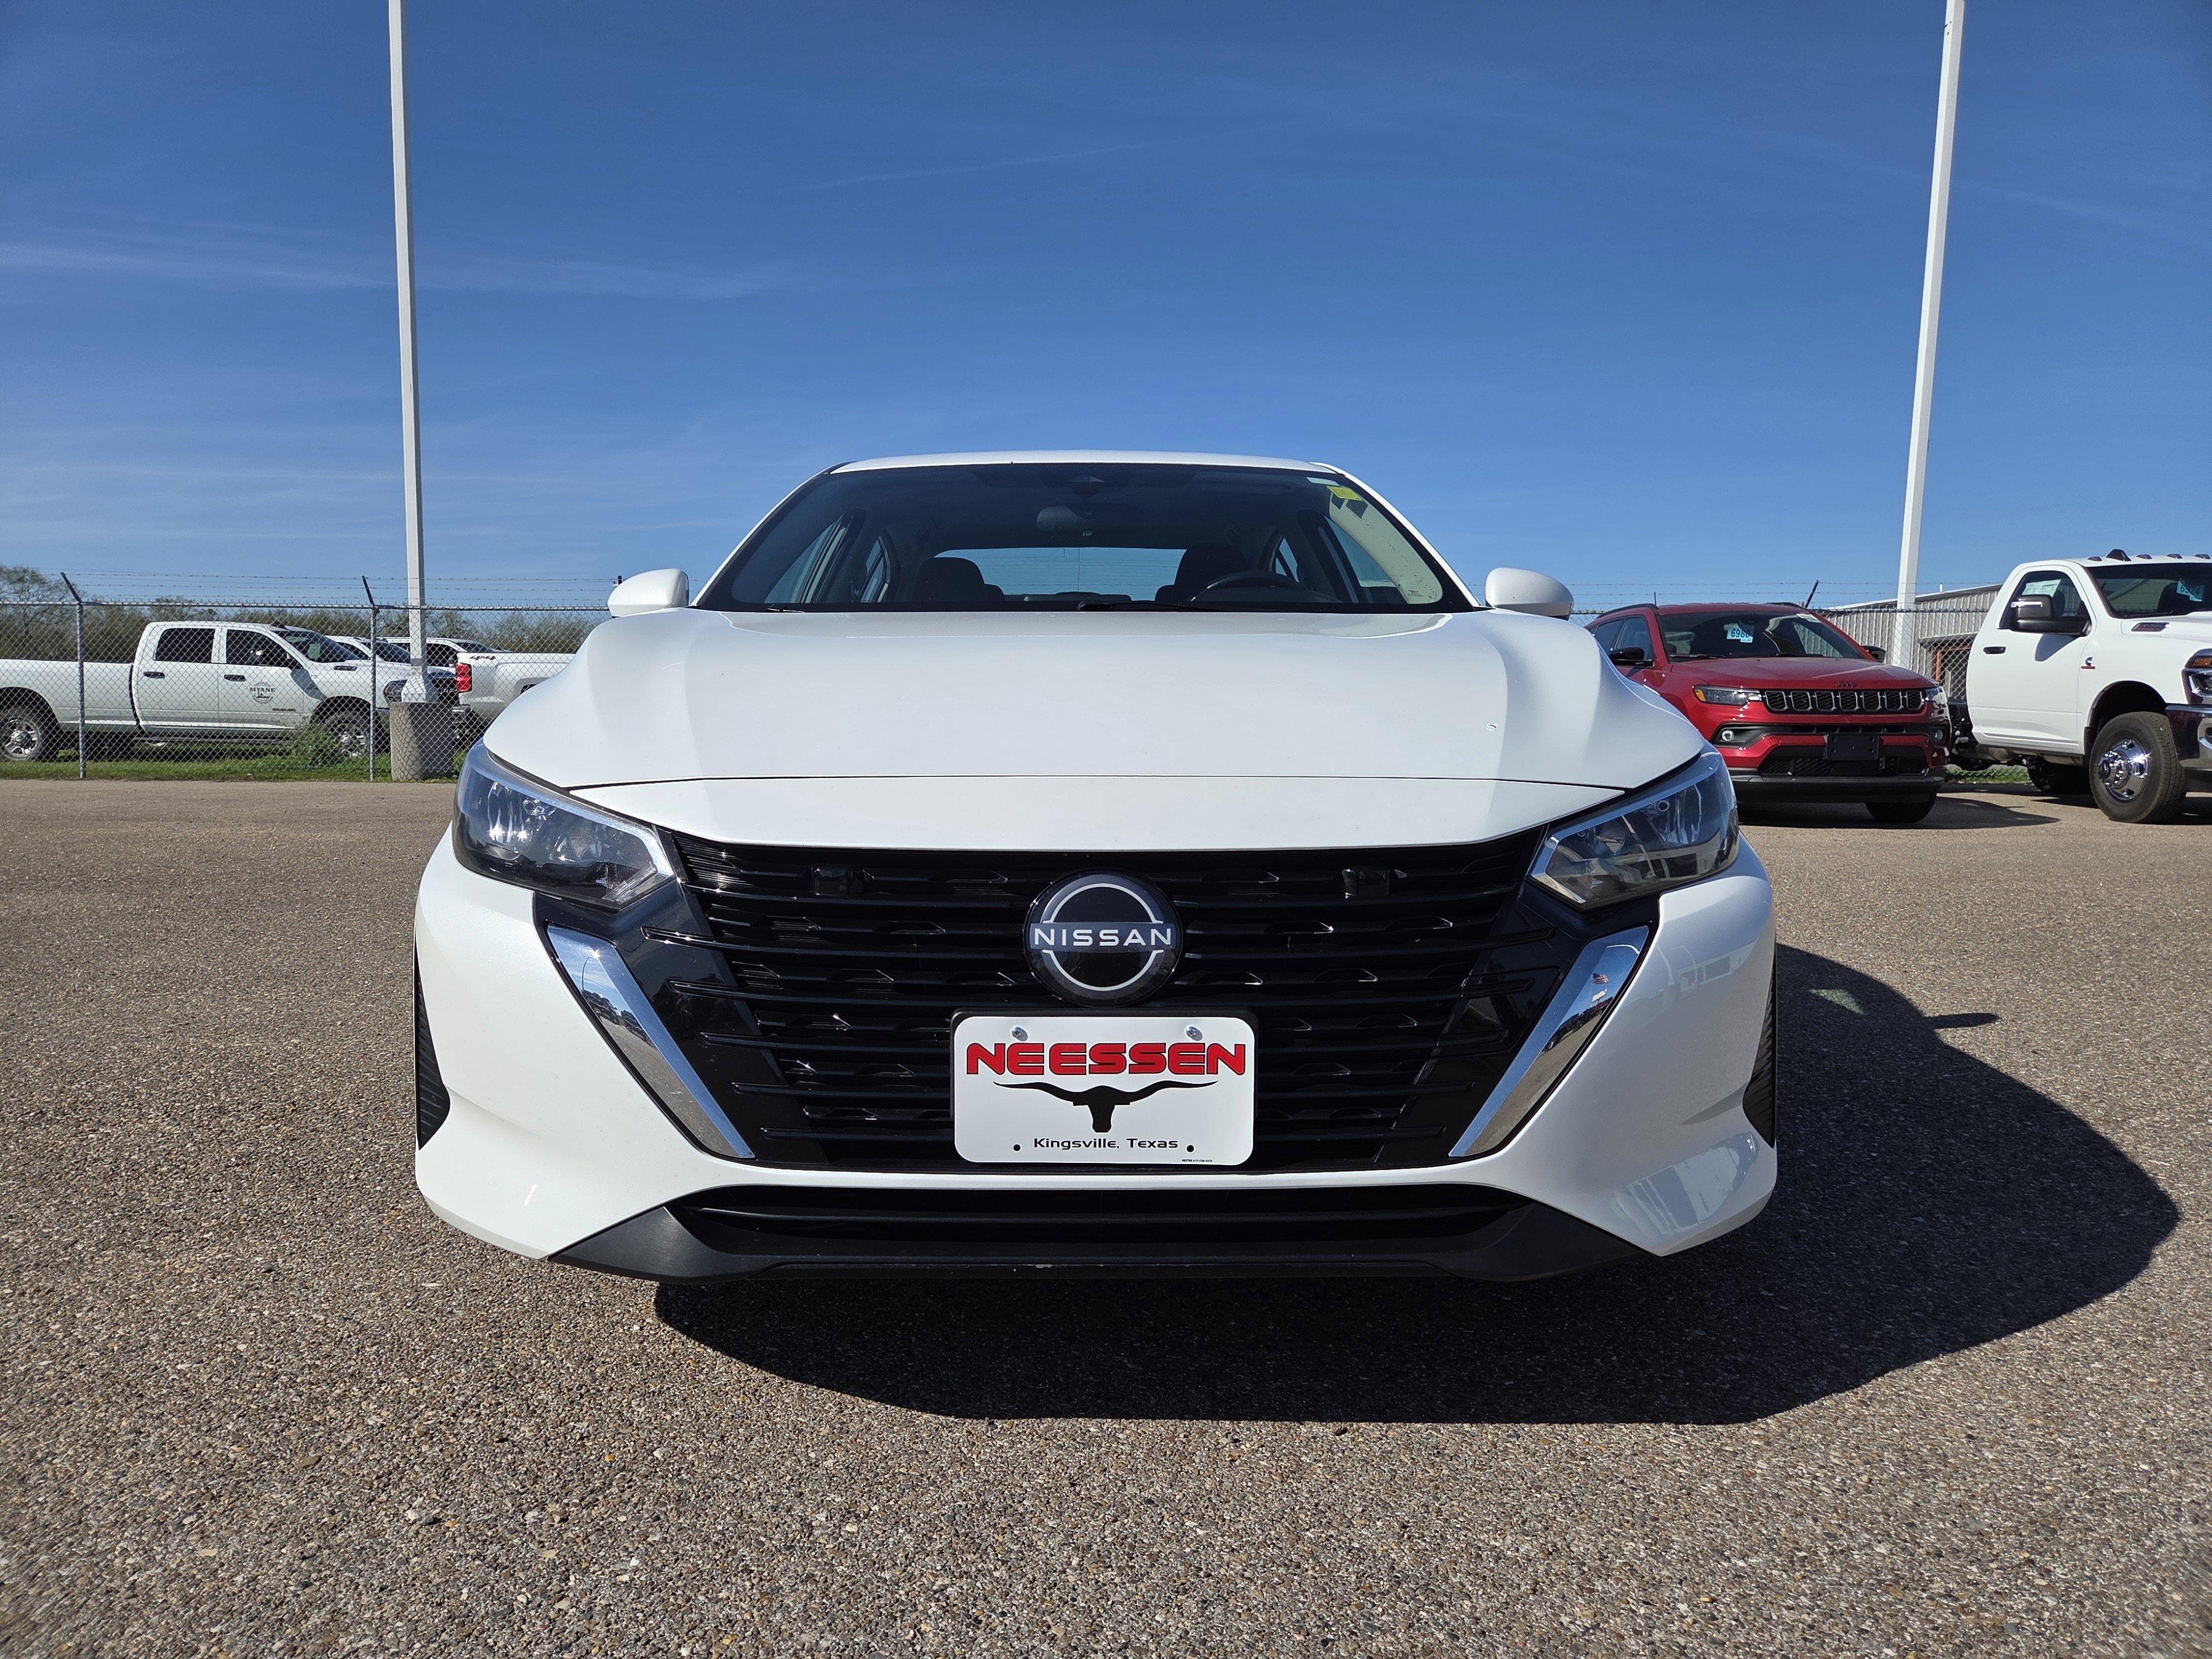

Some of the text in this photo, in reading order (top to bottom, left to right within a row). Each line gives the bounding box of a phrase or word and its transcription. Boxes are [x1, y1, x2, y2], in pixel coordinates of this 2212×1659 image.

[1035, 928, 1171, 946] NISSAN
[966, 1042, 1246, 1076] NEESSEN
[1034, 1138, 1178, 1150] Kingsville, Texas
